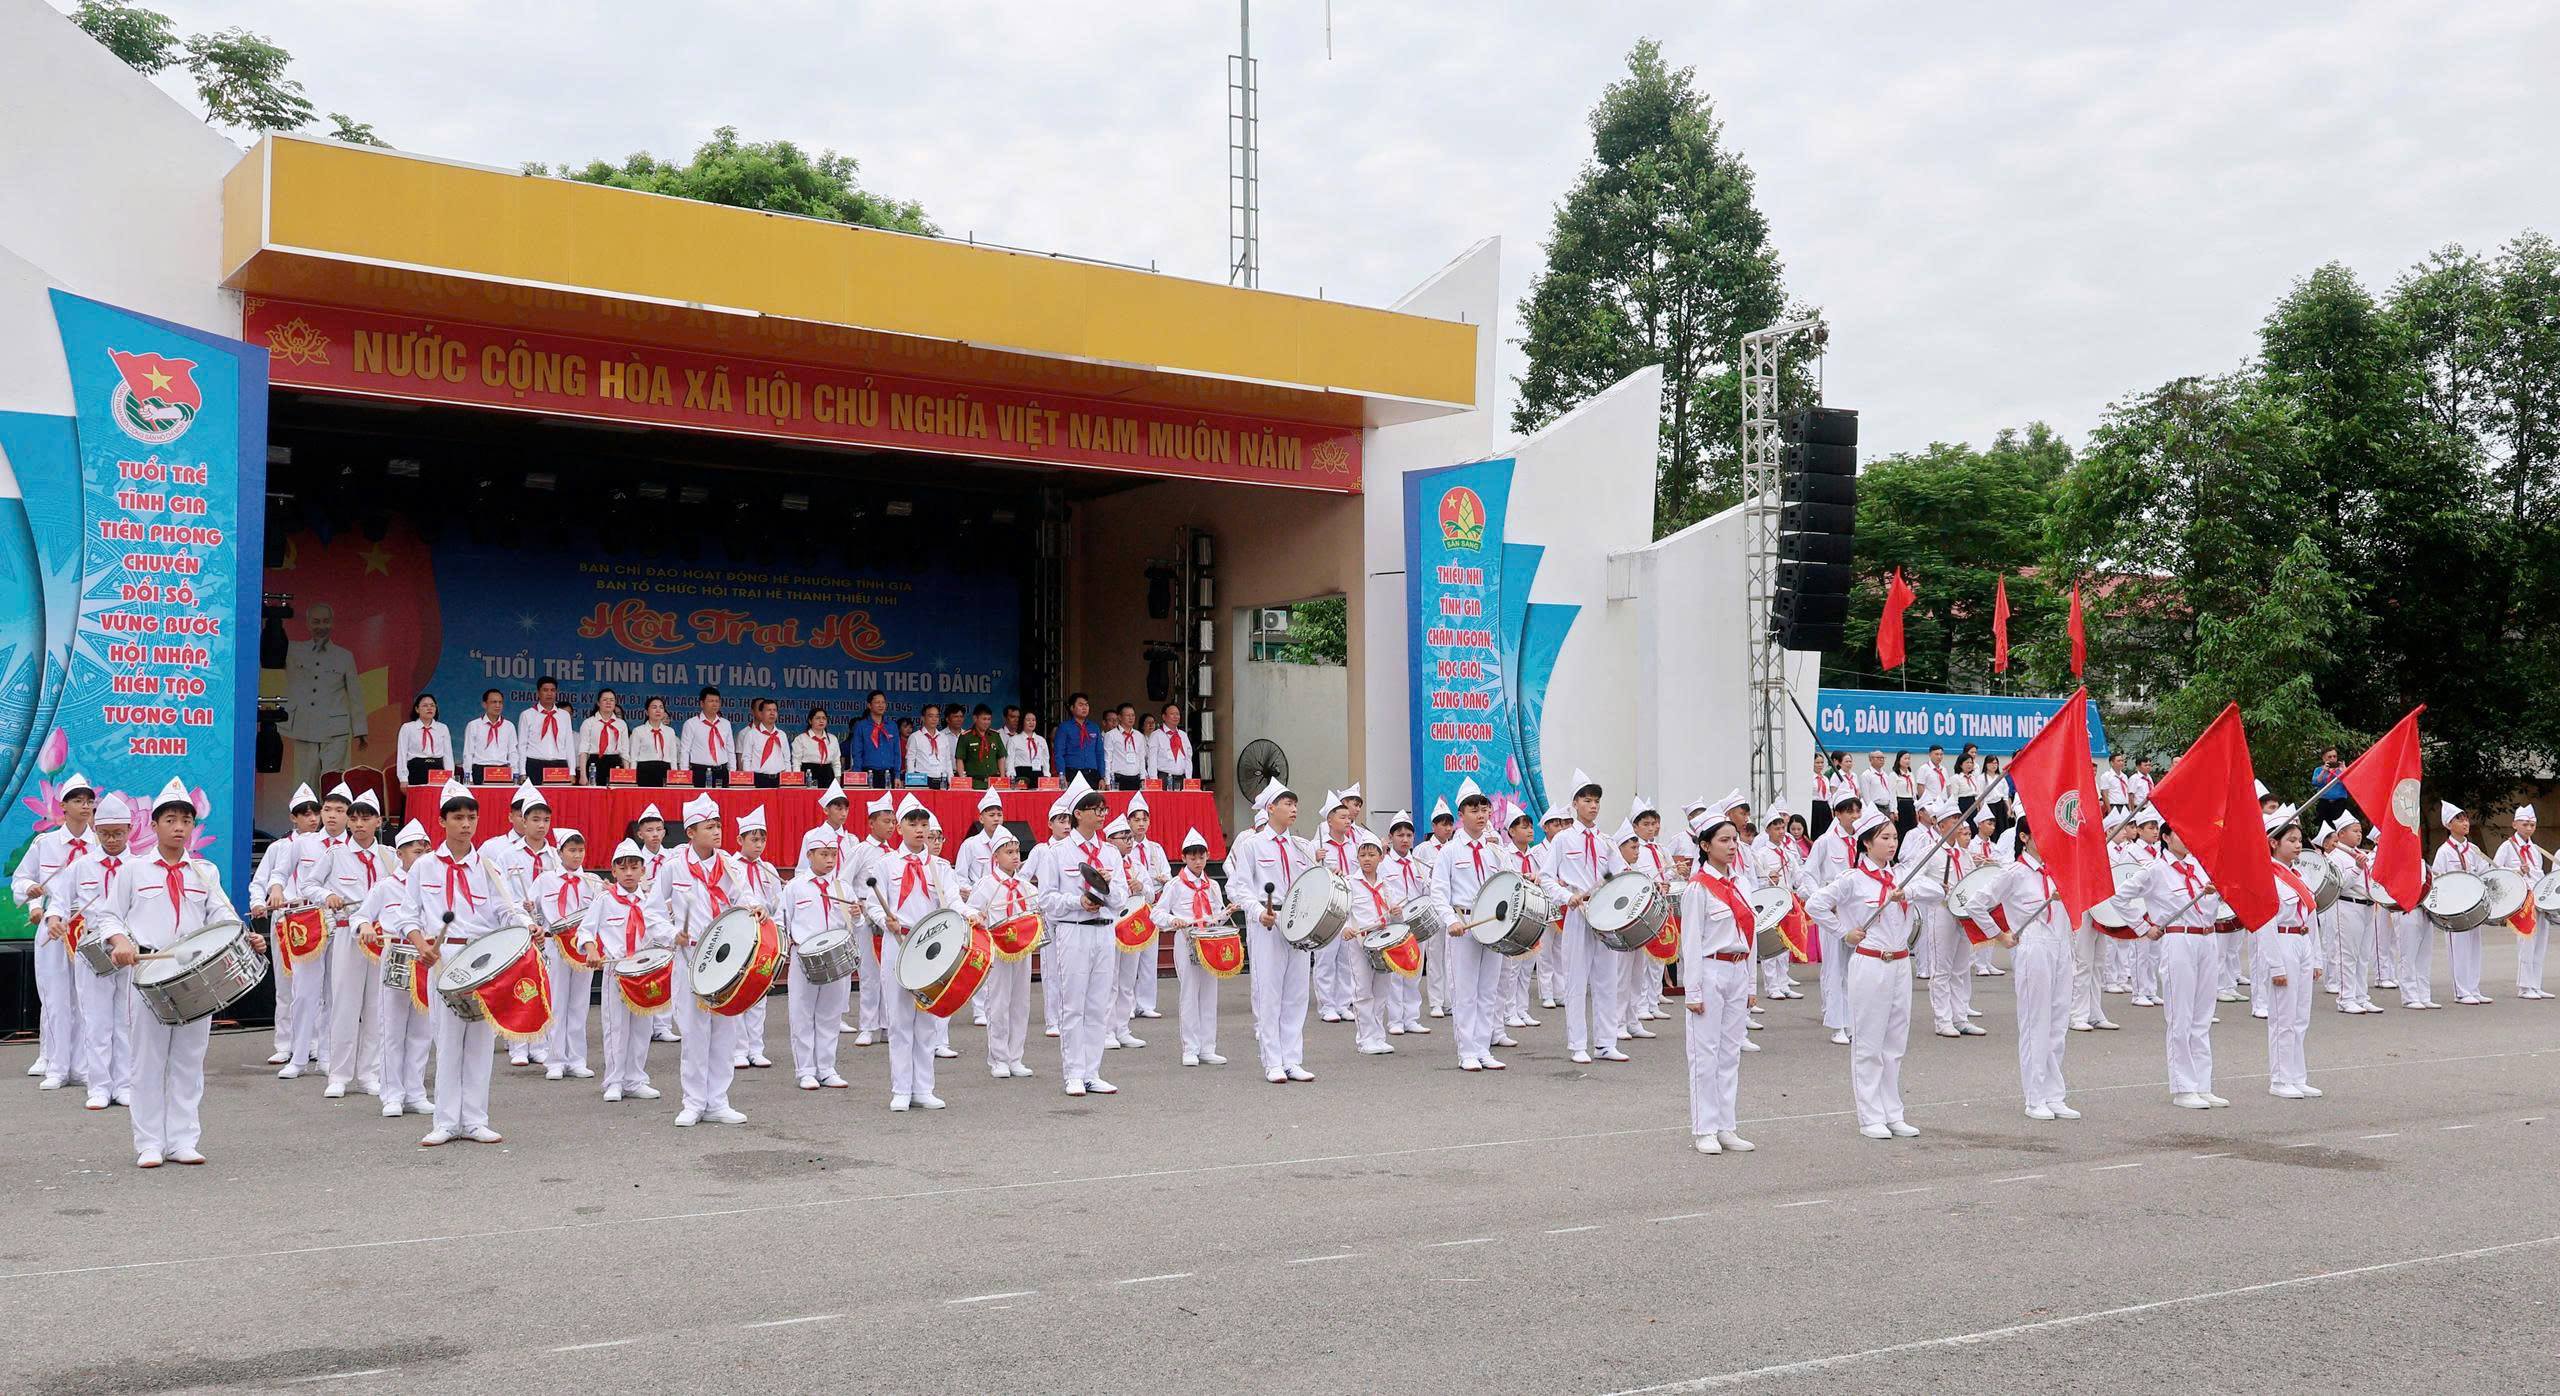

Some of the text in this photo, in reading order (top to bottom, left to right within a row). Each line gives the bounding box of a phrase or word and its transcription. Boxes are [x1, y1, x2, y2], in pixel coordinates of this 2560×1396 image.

[353, 323, 1302, 471] NƯỚC CỘNG HÒA XÃ HỘI CHỦ NGHĨA VIỆT NAM MUÔN NĂM
[118, 455, 207, 485] TUỔI TRẺ
[118, 491, 206, 516] TĨNH GIA
[99, 518, 223, 547] TIÊN PHONG
[123, 549, 200, 576] CHUYỂN
[1437, 558, 1483, 587] THIẾU NHI
[579, 563, 609, 573] BAN
[889, 581, 913, 592] GIA
[122, 576, 199, 608] ĐỔI SỐ,
[596, 579, 626, 590] BAN
[787, 591, 831, 602] THANH
[875, 595, 898, 605] NHI
[1439, 595, 1481, 617] TĨNH GIA
[100, 611, 220, 637] VỮNG BƯỚC
[577, 598, 914, 663] Hội Trại Hè
[1427, 624, 1494, 650] CHĂM NGOAN,
[109, 643, 210, 671] HỘI NHẬP,
[1438, 657, 1484, 684] HỌC GIỎI,
[112, 668, 206, 700] KIẾN TẠO
[543, 652, 584, 681] TRẺ
[593, 657, 644, 683] TĨNH
[652, 662, 688, 685] GIA
[695, 664, 726, 689] TỰ
[729, 659, 777, 690] HÀO,
[783, 662, 839, 689] VỮNG
[845, 669, 878, 690] TIN
[883, 670, 933, 692] THEO
[1432, 687, 1489, 711] XỨNG ĐÁNG
[104, 704, 213, 727] TƯƠNG LAI
[1430, 718, 1492, 741] CHÁU NGOAN
[1821, 704, 1850, 735] CÓ,
[1855, 705, 1890, 733] ĐÂU
[1895, 707, 1928, 734] KHÓ
[1934, 708, 1953, 735] CÓ
[1960, 713, 2013, 737] THANH
[129, 737, 187, 756] XANH
[1444, 749, 1480, 772] BÁC HỒ
[1511, 892, 1520, 922] YAMAHA
[703, 925, 723, 960] YAMAHA
